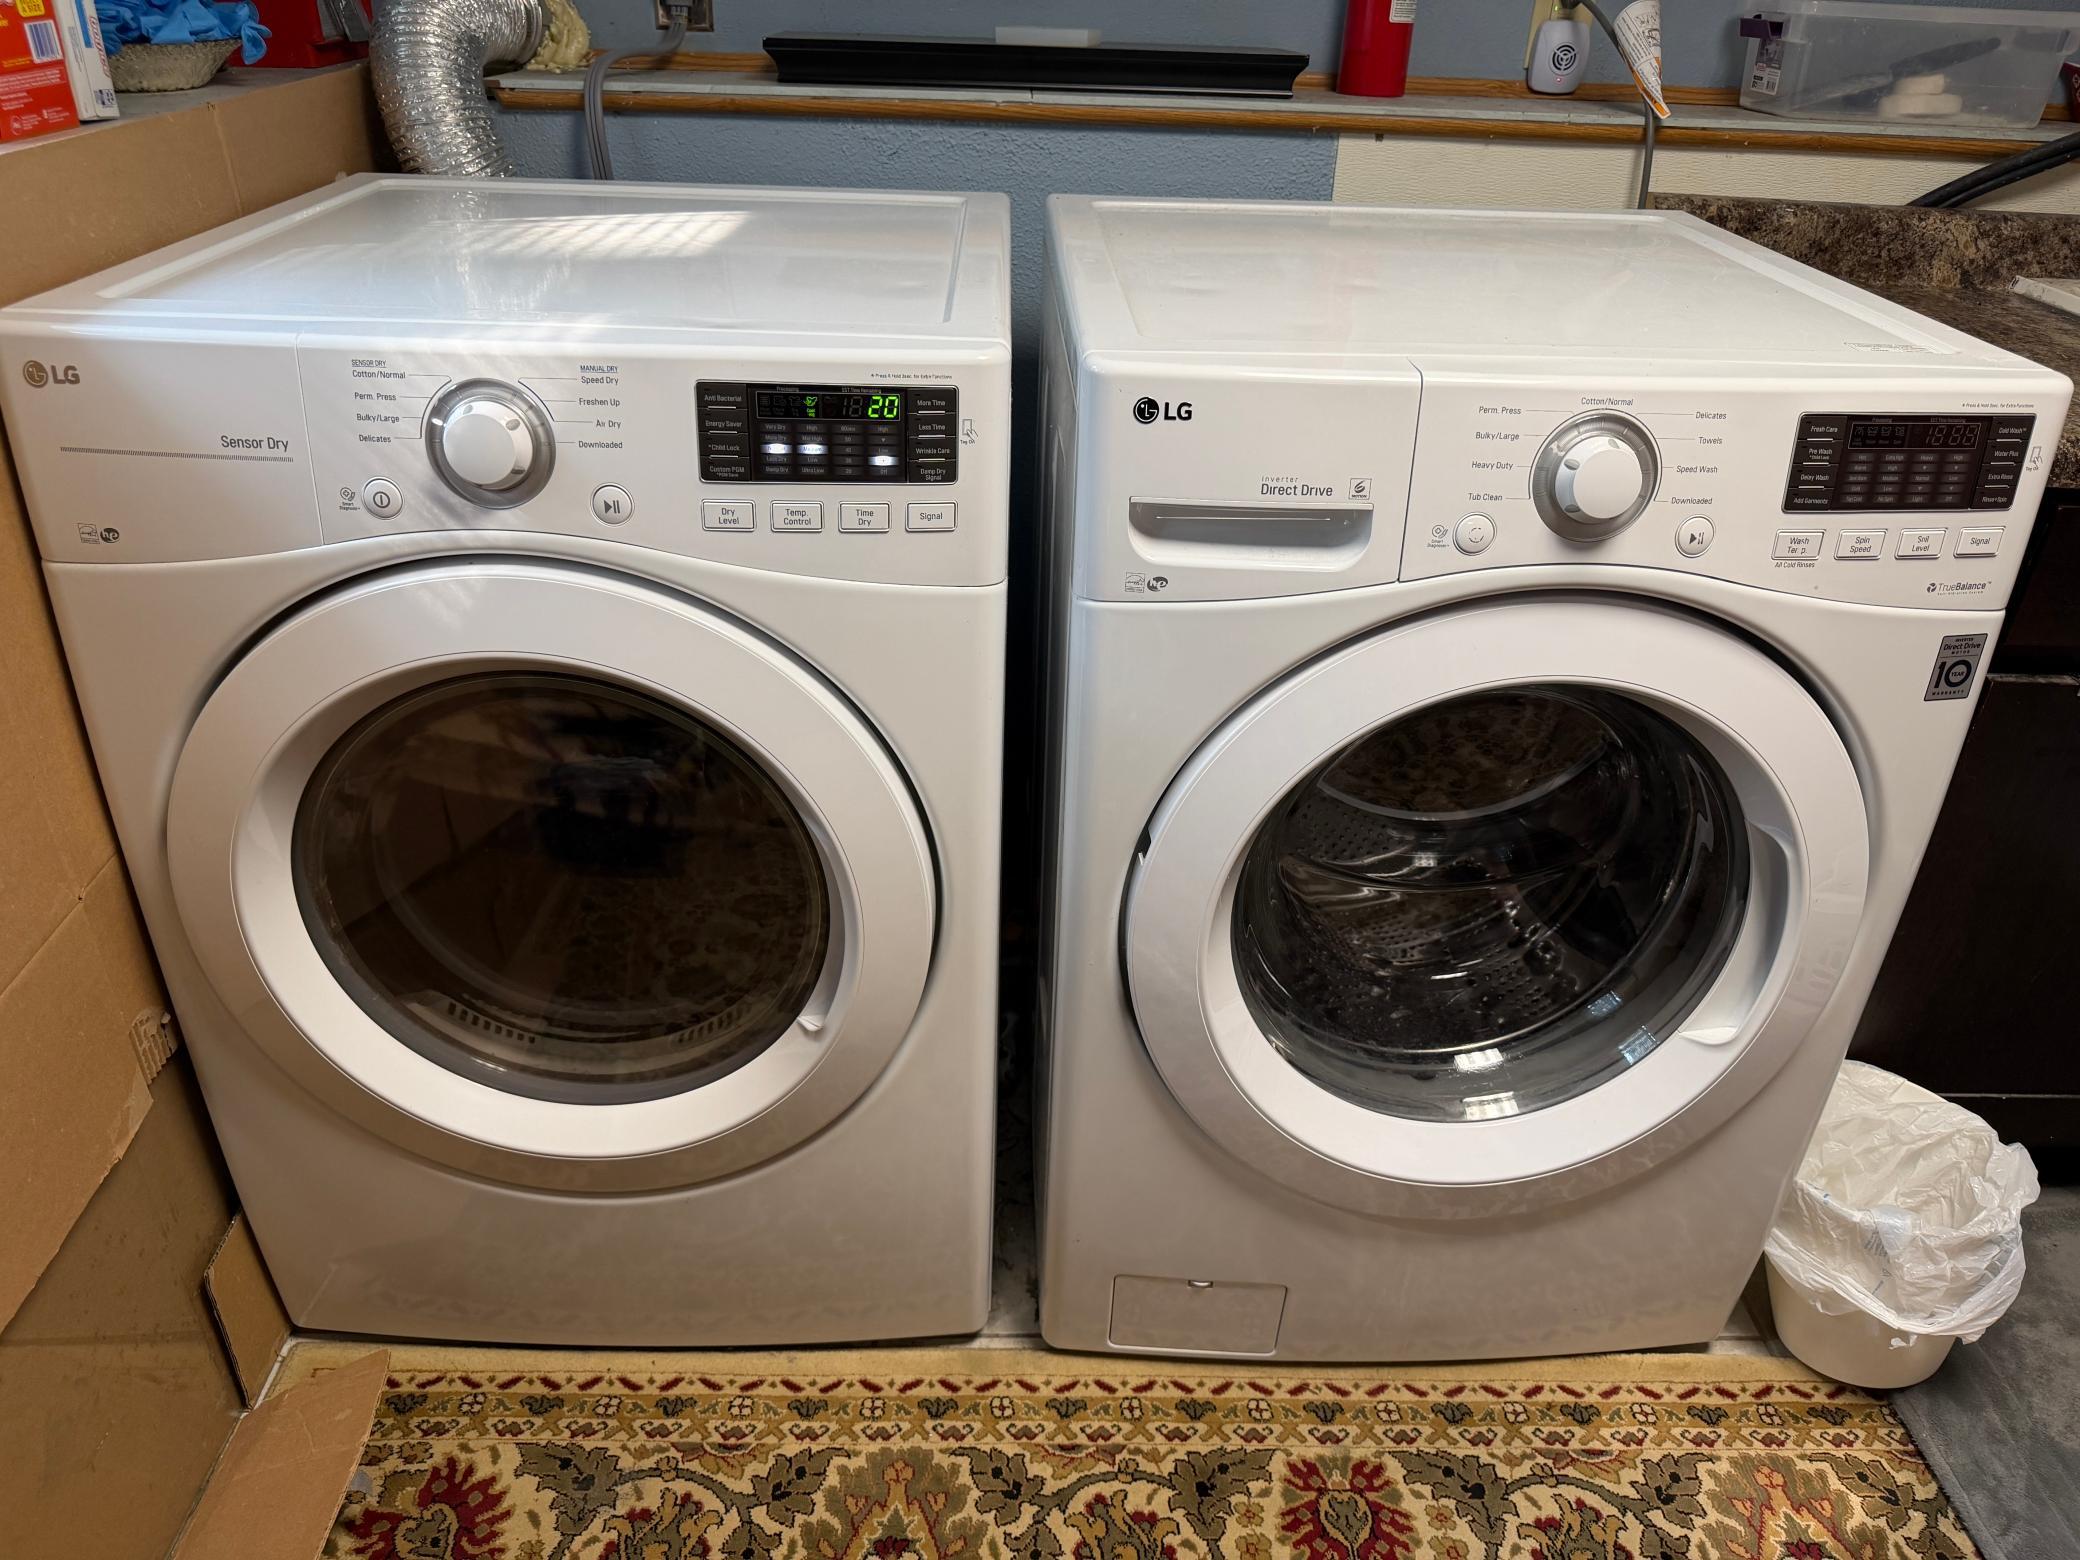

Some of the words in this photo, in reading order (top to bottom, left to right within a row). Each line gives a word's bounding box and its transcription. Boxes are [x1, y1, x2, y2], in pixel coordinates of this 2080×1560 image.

[50, 365, 80, 385] LG
[352, 369, 406, 380] Cotton/Normal
[581, 375, 602, 385] Speed
[603, 376, 619, 386] Dry
[354, 392, 373, 400] Perm.
[376, 392, 397, 401] Press
[579, 398, 608, 407] Freshen
[609, 399, 621, 408] Up
[1581, 397, 1634, 406] Cotton/Normal
[867, 395, 899, 418] 20
[1479, 406, 1499, 415] Perm.
[1501, 407, 1522, 415] Press
[1164, 402, 1193, 421] LG
[1695, 411, 1727, 420] Delicates
[356, 413, 400, 424] Bulky/Large
[596, 419, 606, 428] Air
[608, 420, 621, 429] Dry
[705, 420, 725, 428] Energy
[1810, 425, 1825, 433] Fresh
[359, 434, 391, 443] Delicates
[1475, 431, 1520, 441] Bulky/Large
[1698, 436, 1723, 445] Towels
[221, 435, 264, 449] Sensor
[267, 436, 289, 452] Dry
[578, 440, 623, 450] Downloaded
[709, 465, 731, 473] Custom
[1472, 461, 1494, 471] Heavy
[1495, 461, 1514, 472] Duty
[1676, 465, 1697, 475] Speed
[1699, 465, 1718, 474] Wash
[920, 468, 935, 476] Damp
[936, 468, 946, 476] Dry
[925, 474, 942, 482] Signal
[1260, 483, 1298, 496] Direct
[1301, 484, 1333, 497] Drive
[1468, 493, 1481, 501] Tub
[1483, 493, 1503, 501] Clean
[1671, 497, 1713, 506] Downloaded
[721, 507, 735, 519] Dry
[785, 509, 809, 519] Temp.
[856, 509, 875, 518] Time
[919, 511, 943, 522] Signal
[718, 516, 740, 525] Level
[783, 517, 812, 527] Control
[858, 517, 872, 528] Dry
[1790, 537, 1810, 545] Wash
[1855, 537, 1871, 545] Spin
[1917, 535, 1930, 544] Soil
[1970, 537, 1991, 546] Signal
[1850, 545, 1872, 554] Speed
[1911, 544, 1930, 552] Level
[1943, 642, 1964, 651] Direct
[1964, 642, 1981, 650] Drive
[1934, 659, 1973, 689] 10
